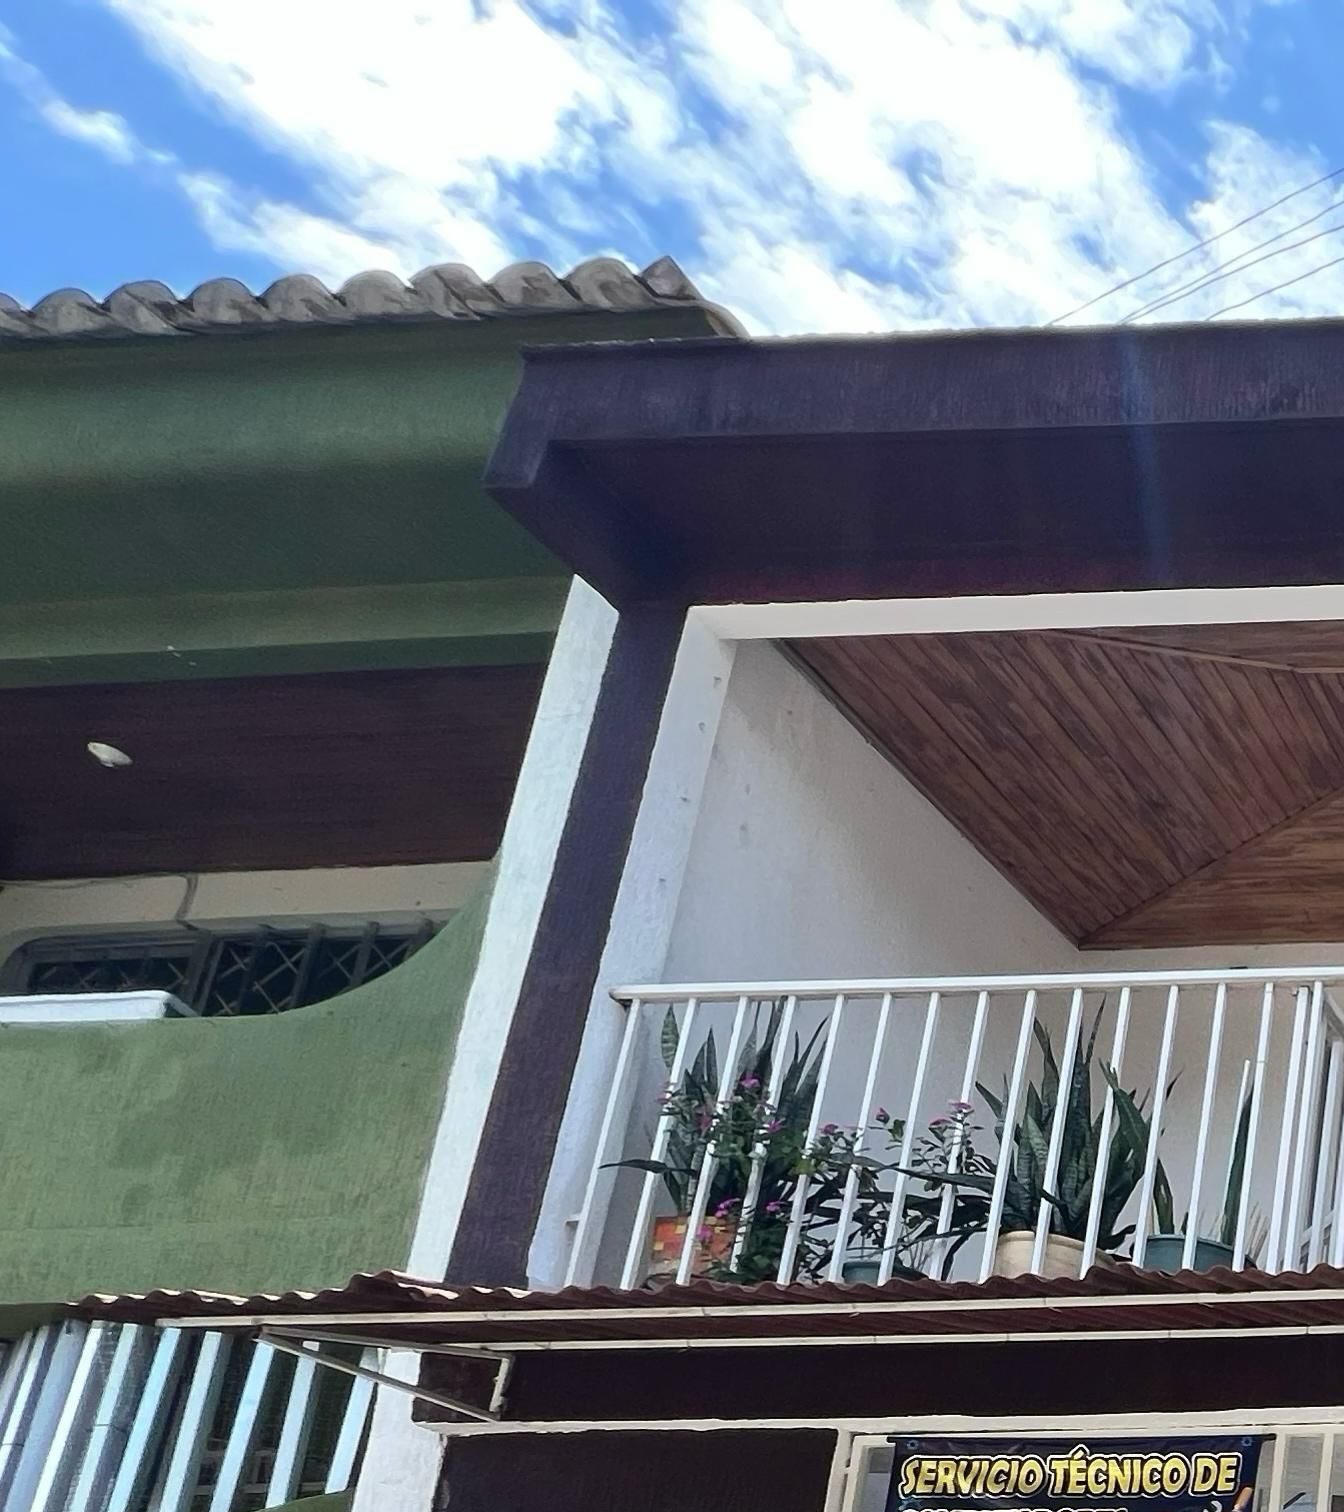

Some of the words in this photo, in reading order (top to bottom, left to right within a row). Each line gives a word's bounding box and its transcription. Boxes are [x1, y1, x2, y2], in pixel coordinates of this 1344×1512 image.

[900, 1455, 1048, 1498] SERVICIO
[1050, 1444, 1188, 1498] TÉCNICO
[1189, 1453, 1241, 1495] DE
